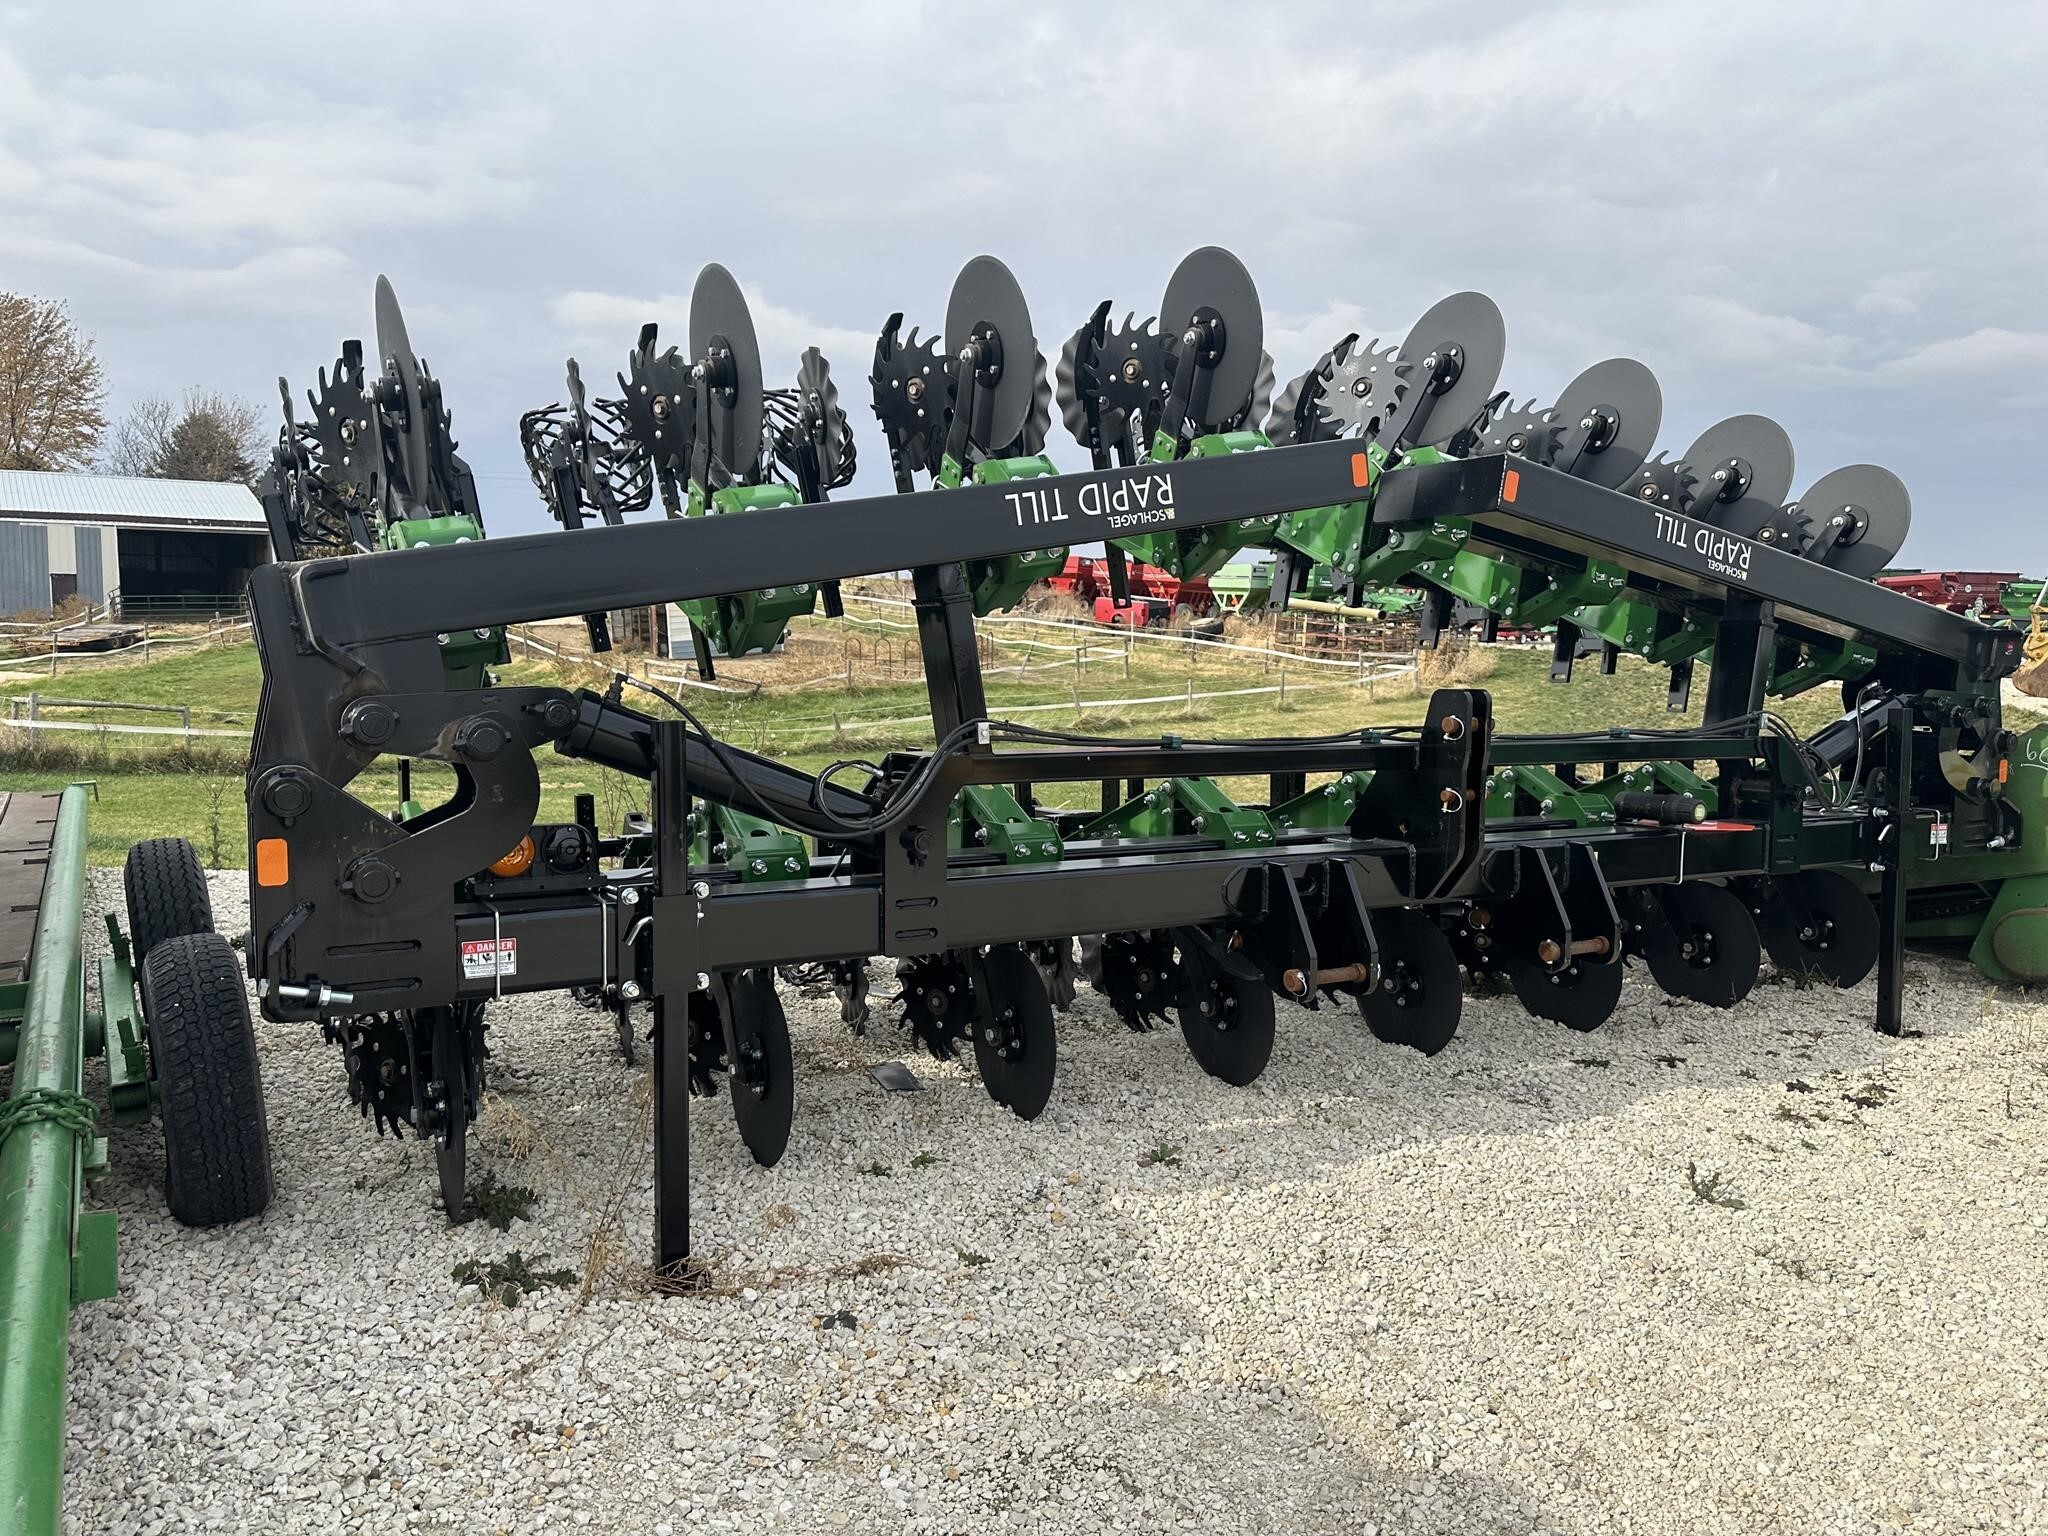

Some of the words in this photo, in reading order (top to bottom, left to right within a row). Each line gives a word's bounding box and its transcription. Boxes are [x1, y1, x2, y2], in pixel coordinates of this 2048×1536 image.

[1004, 488, 1069, 526] TILL
[1078, 473, 1174, 516] RAPID
[1107, 508, 1167, 528] SCHLAGEL
[1654, 512, 1687, 548] TILL
[1694, 529, 1752, 569] RAPID
[1707, 558, 1742, 579] SCHLAGEL
[476, 941, 513, 952] DANER
